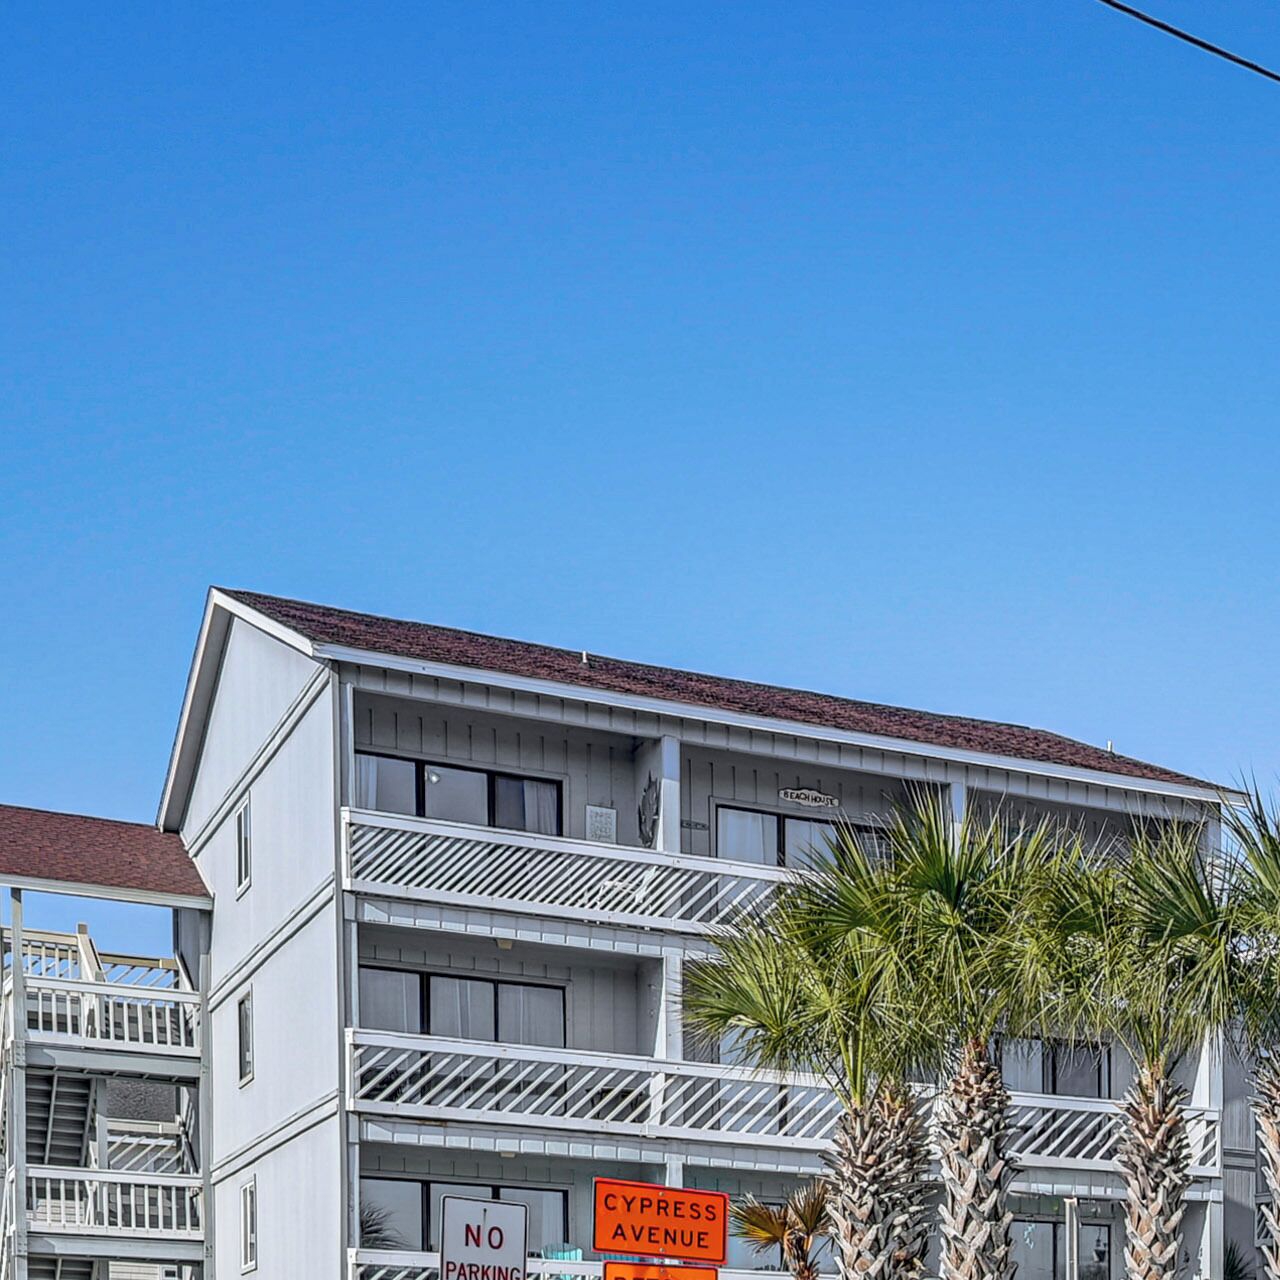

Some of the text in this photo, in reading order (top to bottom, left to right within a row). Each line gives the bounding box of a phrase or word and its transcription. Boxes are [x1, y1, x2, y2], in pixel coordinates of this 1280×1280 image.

[783, 790, 834, 806] BEACH HOUSE
[604, 1193, 717, 1222] CYPRESS
[464, 1223, 504, 1250] NO
[611, 1223, 709, 1249] AVENUE
